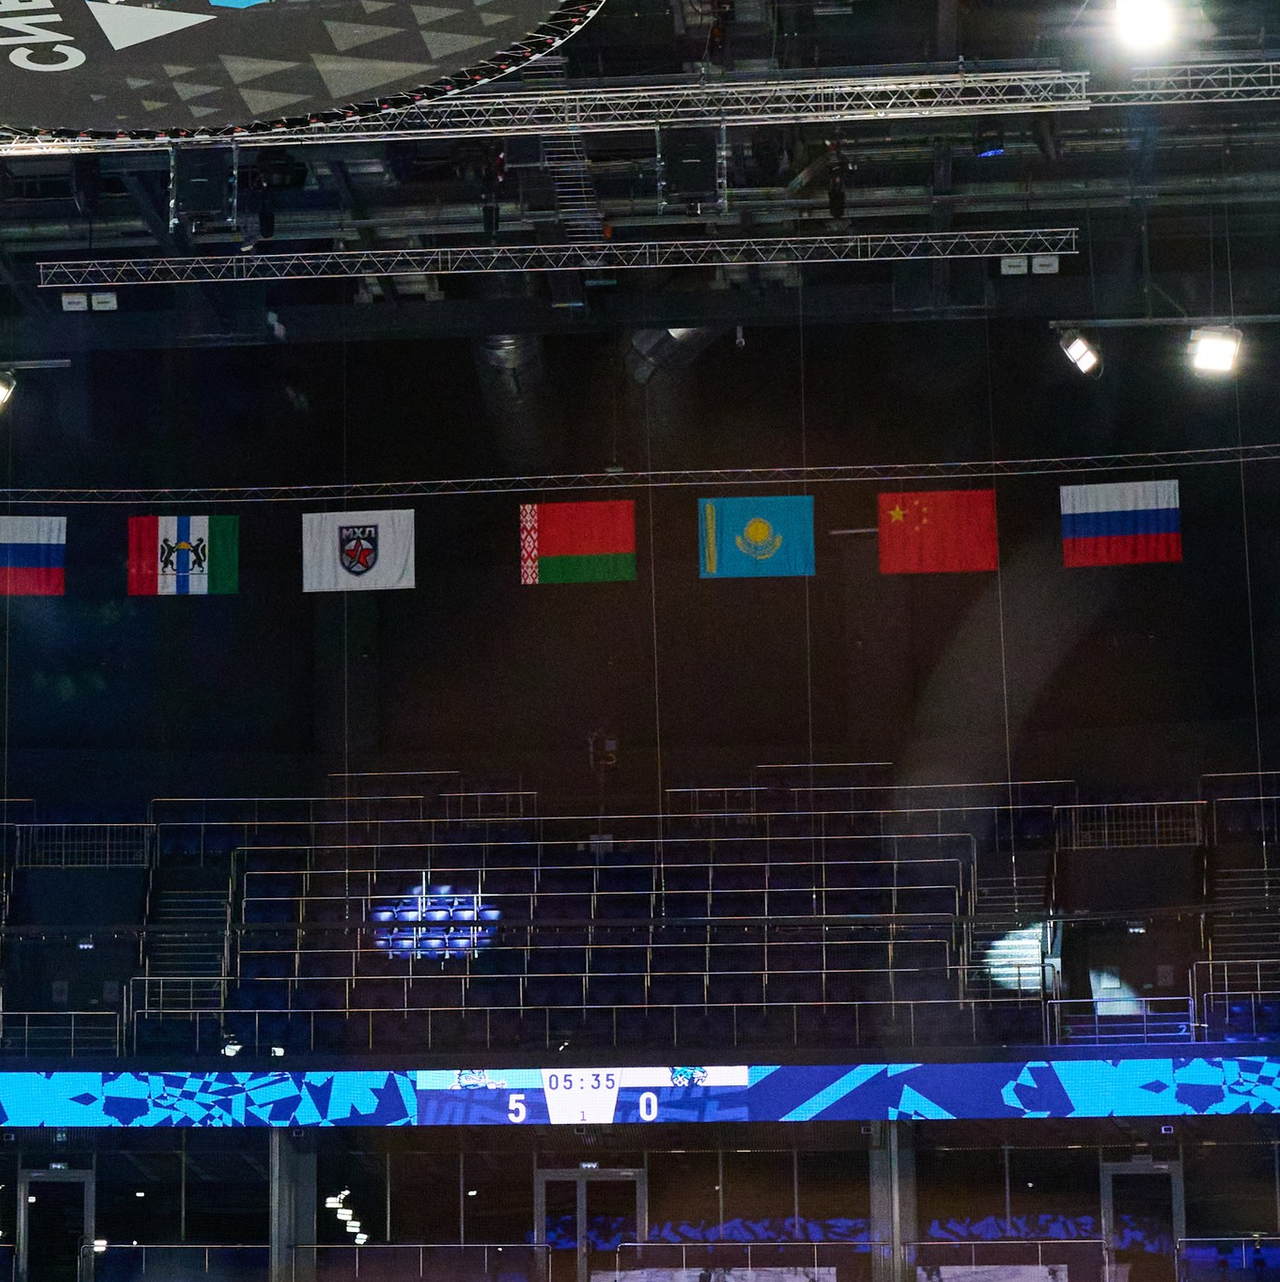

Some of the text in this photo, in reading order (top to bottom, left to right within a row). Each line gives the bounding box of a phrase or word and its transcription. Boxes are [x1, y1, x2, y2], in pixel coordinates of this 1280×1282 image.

[341, 527, 376, 538] МХЛ
[548, 1073, 616, 1091] 05:35
[508, 1093, 527, 1123] 5
[639, 1092, 658, 1122] 0
[579, 1111, 588, 1122] 1
